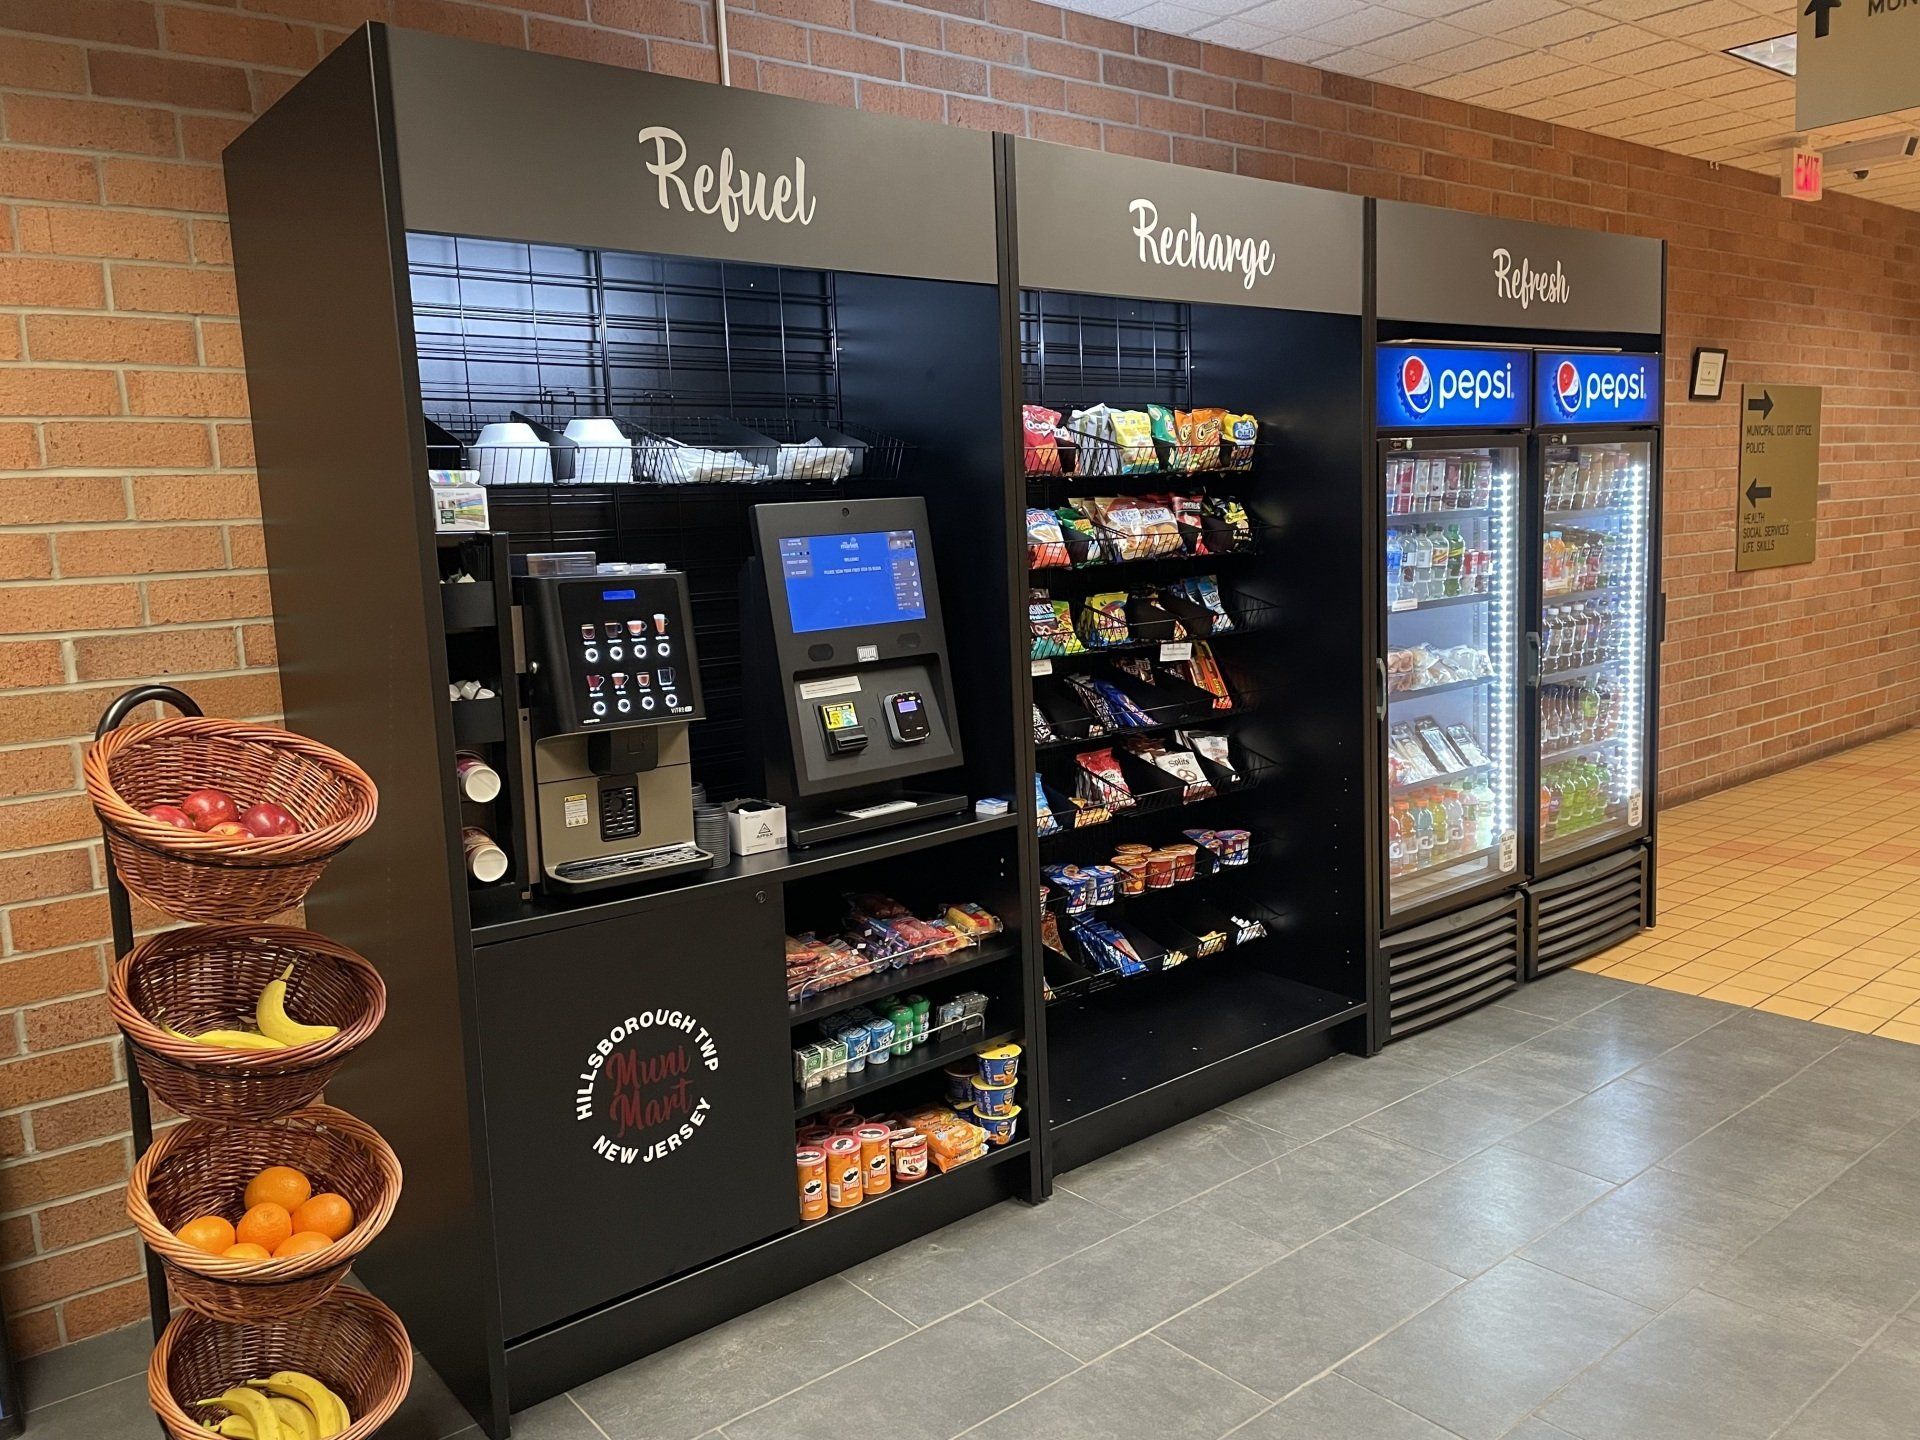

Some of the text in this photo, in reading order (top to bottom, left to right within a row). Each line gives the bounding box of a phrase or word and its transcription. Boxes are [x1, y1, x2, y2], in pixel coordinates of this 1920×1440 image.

[638, 126, 816, 233] Refuel
[1796, 153, 1821, 192] EXIT
[1128, 198, 1276, 290] Recharge
[1492, 248, 1570, 310] Refresh
[1439, 362, 1512, 409] pepsi
[1585, 366, 1645, 409] pepsi
[1745, 442, 1766, 454] POLICE
[1746, 424, 1813, 437] MUNICIPAL COURT OFFICE
[1140, 508, 1165, 517] PARTY
[1743, 512, 1766, 524] HEALTH
[1743, 523, 1790, 538] SOCIAL SERVICES
[1742, 539, 1775, 553] LIFE SKILLS
[1168, 757, 1190, 768] Splits
[576, 1008, 720, 1121] HILLSBOROUGH TWP
[605, 1045, 692, 1096] Muni
[609, 1078, 693, 1138] Mart
[592, 1096, 712, 1165] NEW JERSEY
